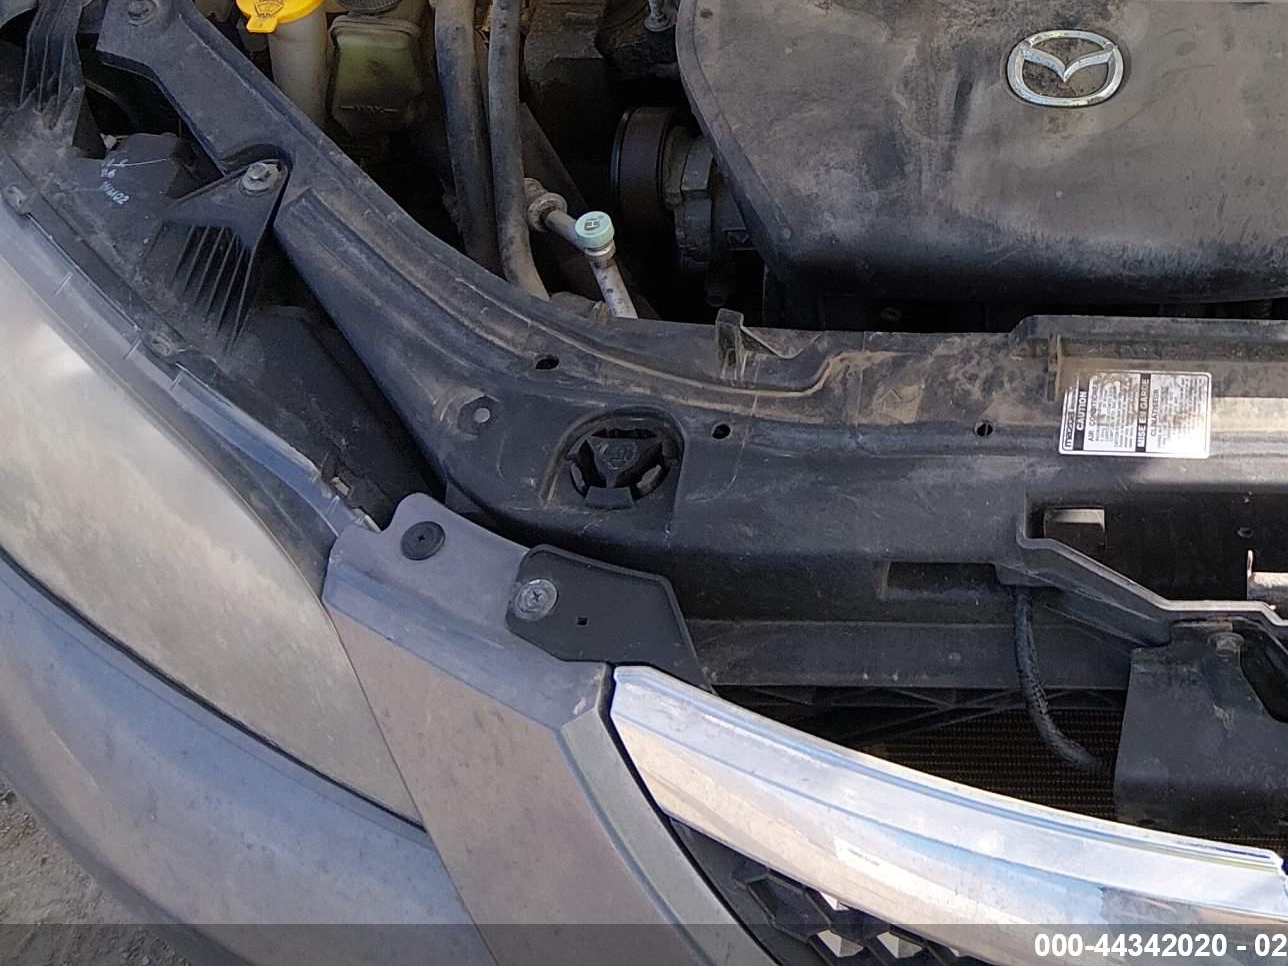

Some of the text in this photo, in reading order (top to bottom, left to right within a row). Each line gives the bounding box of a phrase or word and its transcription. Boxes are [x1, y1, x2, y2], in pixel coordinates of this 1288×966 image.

[1076, 390, 1088, 432] CAUTION
[1136, 377, 1150, 448] MISE EN GARDE
